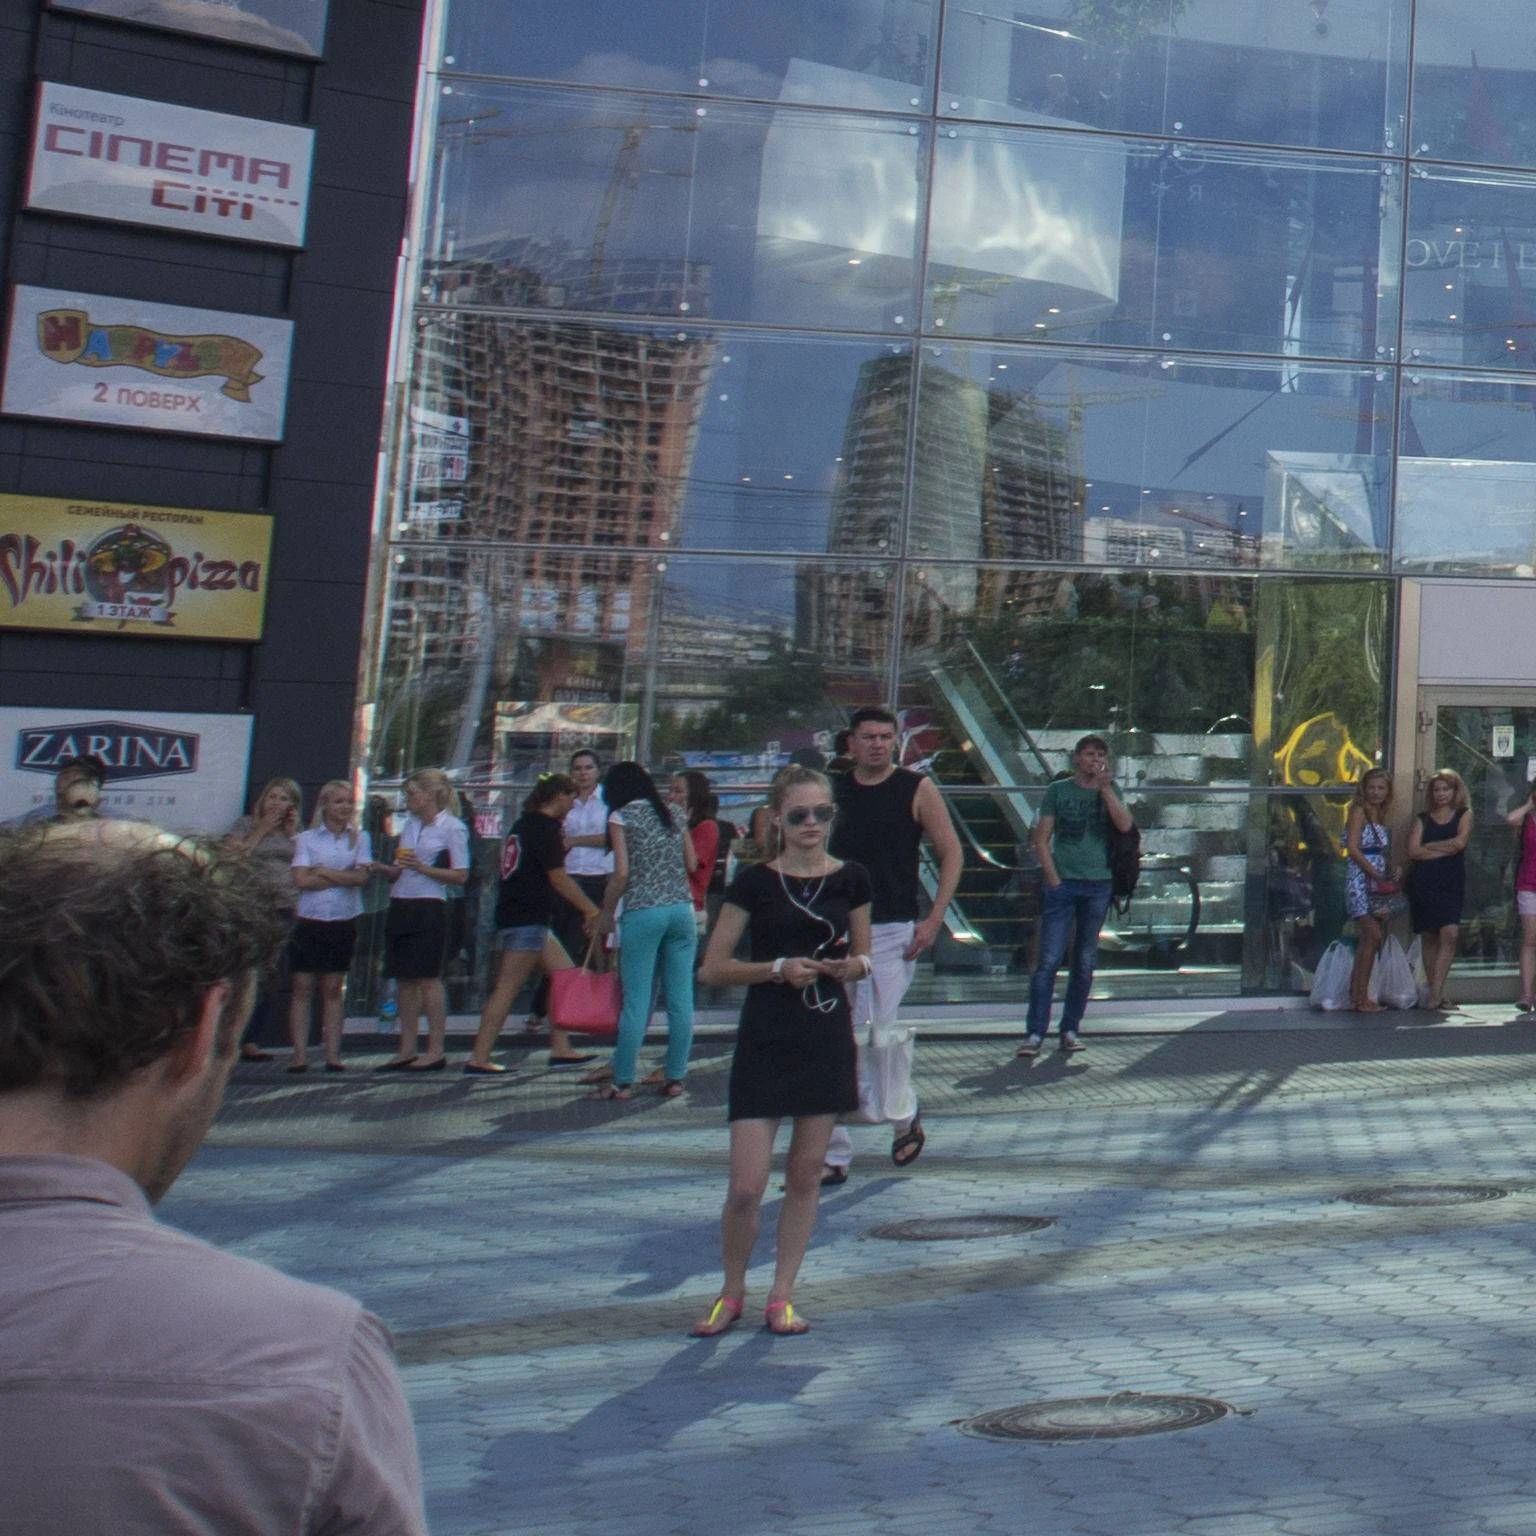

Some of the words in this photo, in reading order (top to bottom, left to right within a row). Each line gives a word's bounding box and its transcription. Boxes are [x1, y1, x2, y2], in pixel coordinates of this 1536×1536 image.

[49, 102, 126, 128] Кінотеатр
[44, 122, 291, 190] CINEMA
[1404, 238, 1482, 269] OVE
[92, 382, 108, 403] 2
[116, 388, 201, 412] ПОВЕРХ
[67, 504, 139, 521] СЕМЕЙНЫЙ
[141, 511, 205, 525] РЕСТОРАН
[168, 551, 261, 608] pizza
[109, 605, 152, 619] ЭТАЖ
[22, 732, 191, 769] ZARINA
